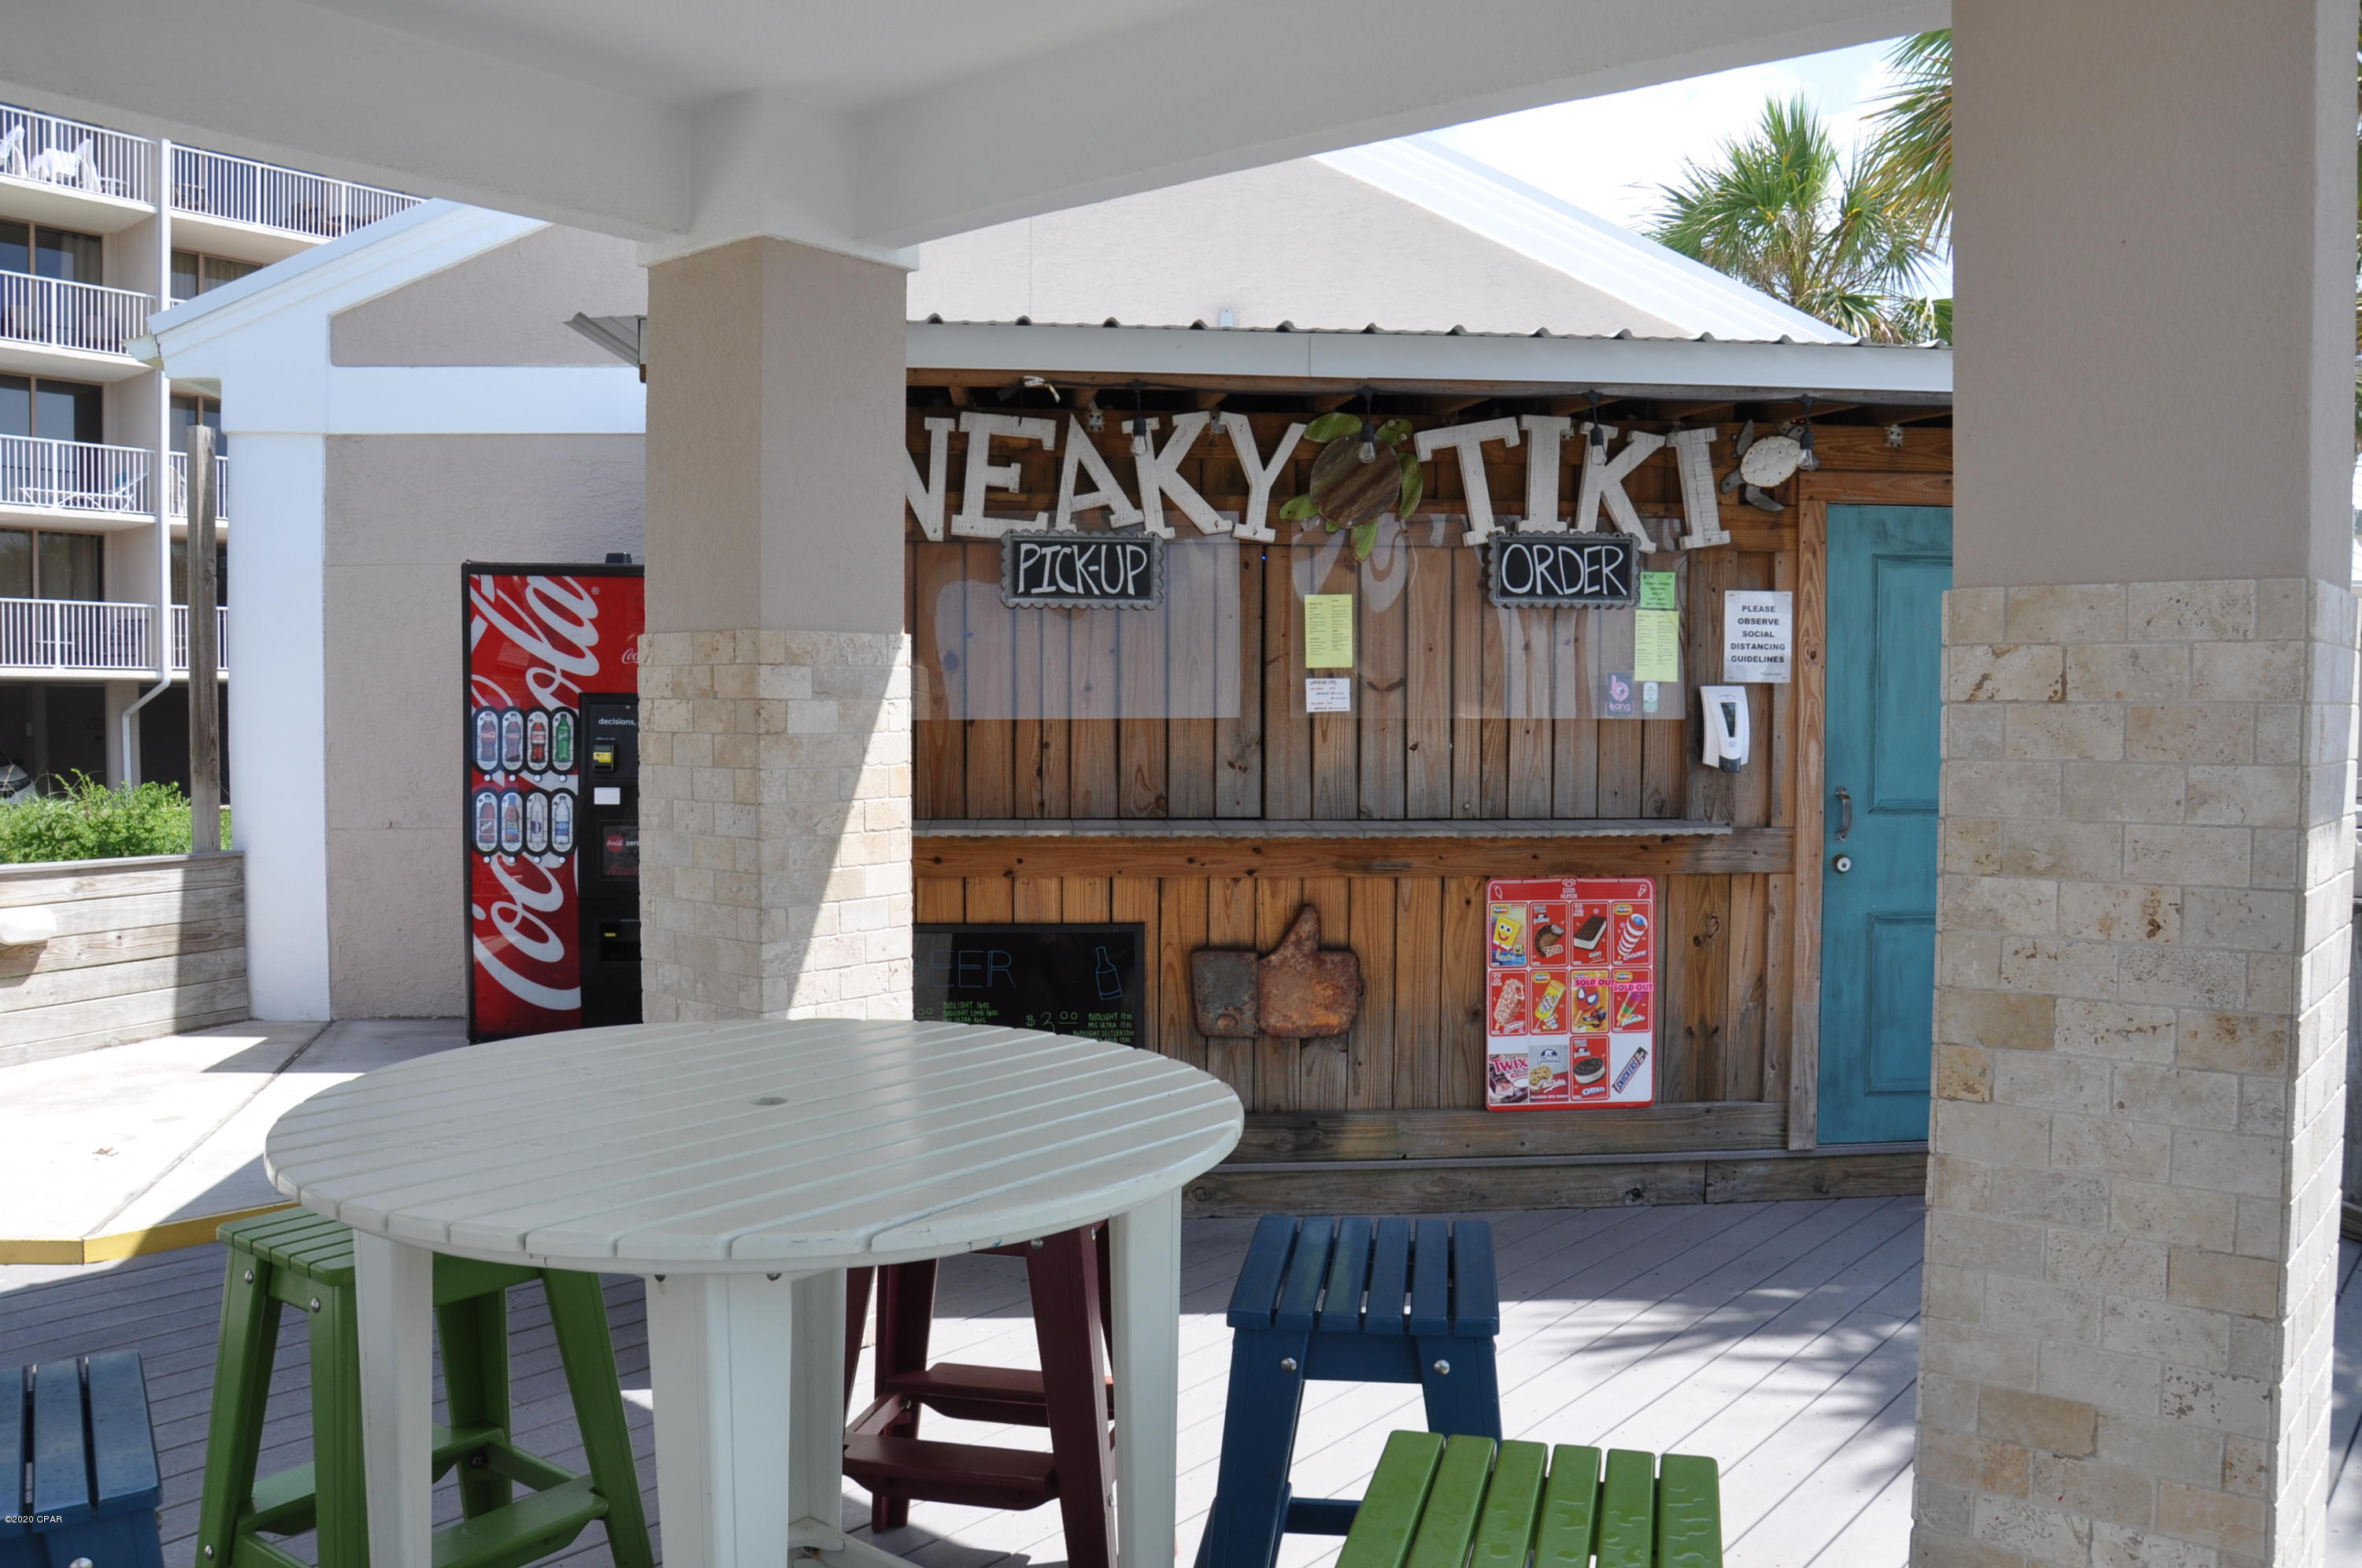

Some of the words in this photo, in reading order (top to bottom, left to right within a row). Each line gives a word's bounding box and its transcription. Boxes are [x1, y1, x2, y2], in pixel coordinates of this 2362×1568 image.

[1413, 413, 1731, 553] TIKI
[1017, 543, 1147, 596] PICK-UP
[1501, 543, 1627, 597] ORDER
